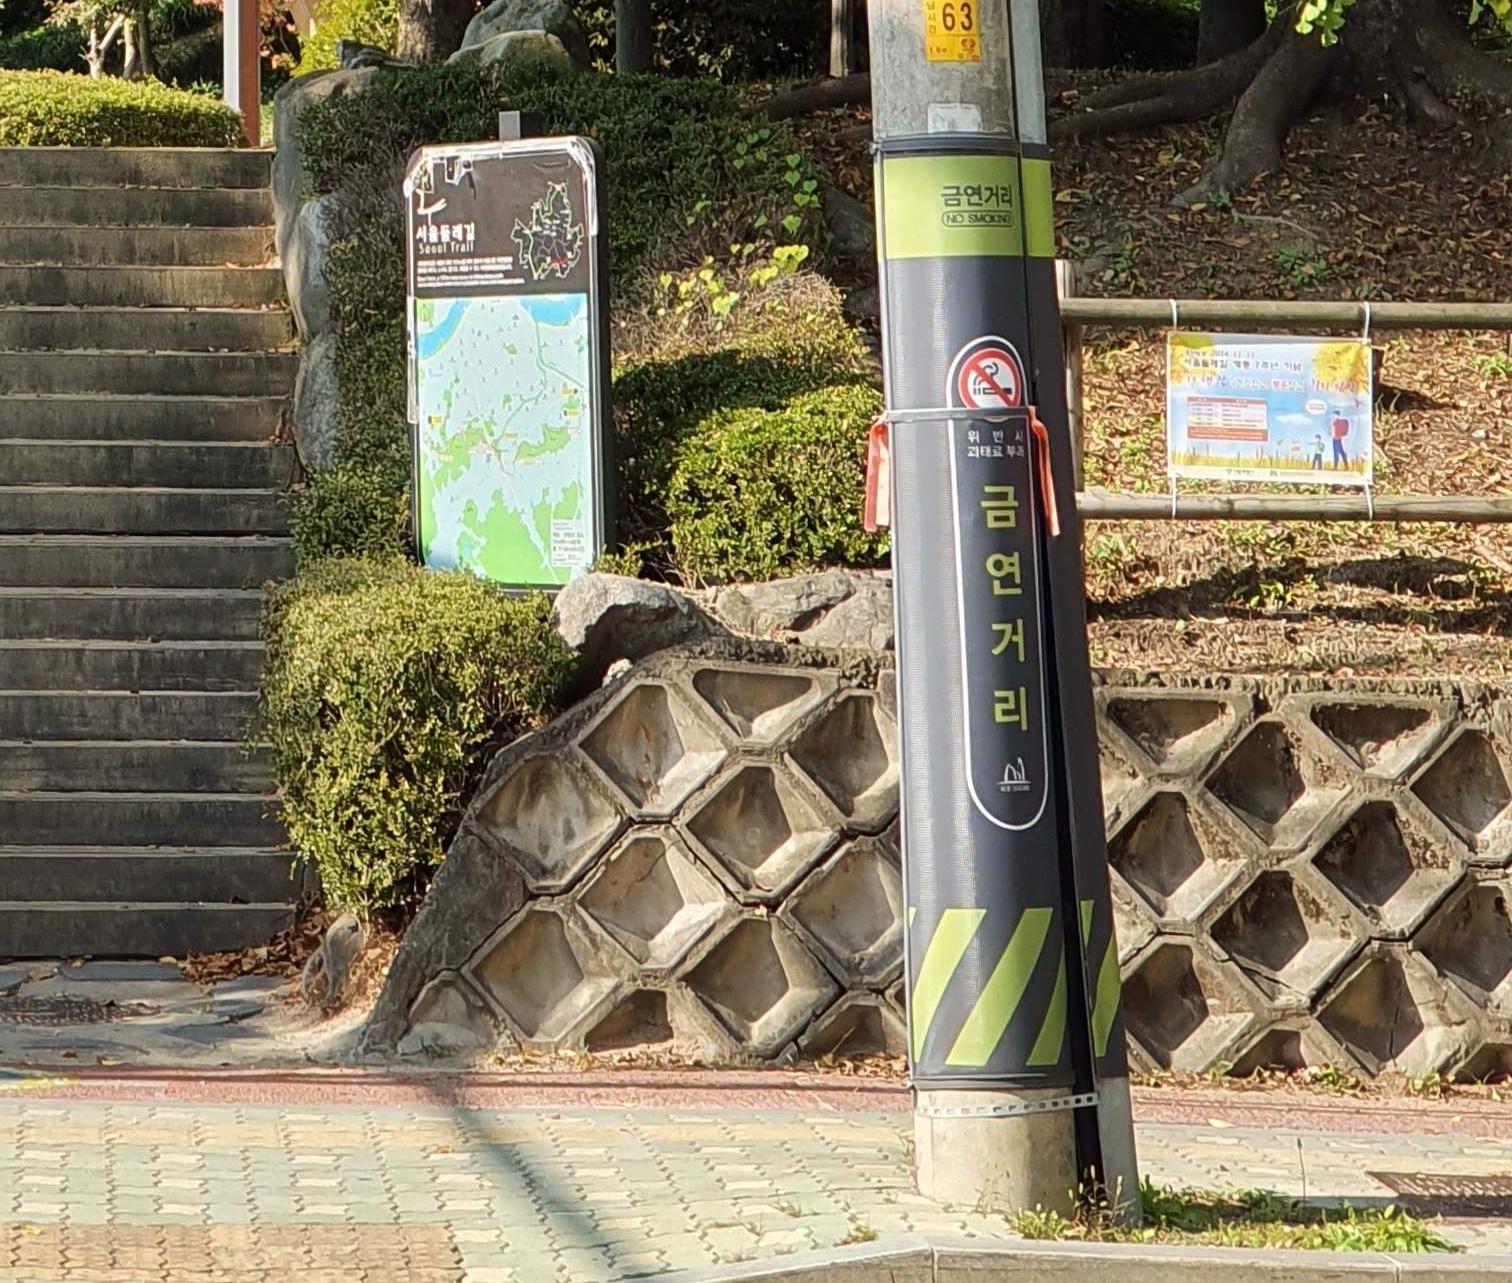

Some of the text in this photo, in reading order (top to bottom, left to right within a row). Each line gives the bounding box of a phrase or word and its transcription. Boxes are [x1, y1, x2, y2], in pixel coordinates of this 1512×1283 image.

[942, 2, 973, 31] 63
[940, 183, 1013, 208] 금연거리
[945, 213, 1011, 224] NO SMOKING
[418, 239, 474, 255] Seoul Trail
